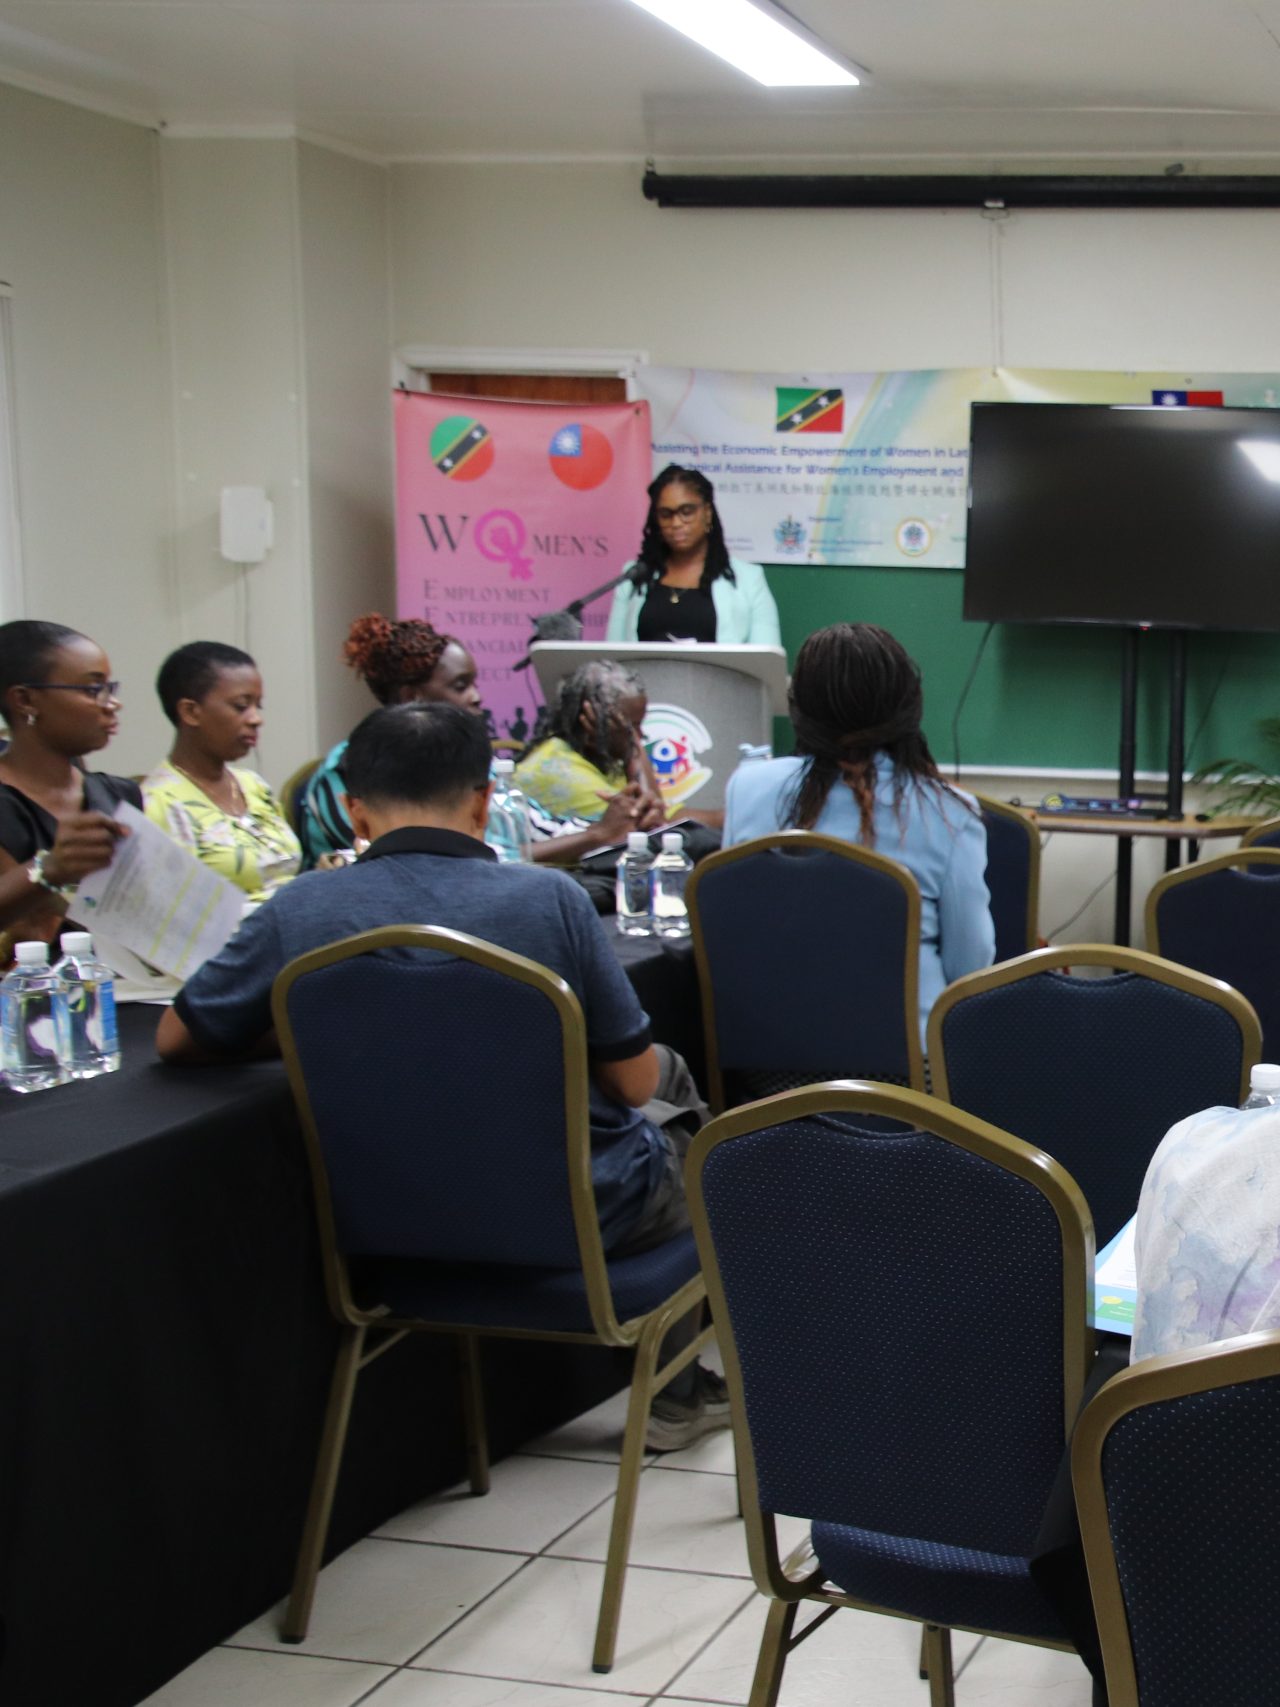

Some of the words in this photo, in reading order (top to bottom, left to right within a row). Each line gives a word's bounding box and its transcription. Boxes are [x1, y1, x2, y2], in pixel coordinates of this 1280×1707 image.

[701, 443, 718, 454] the
[722, 444, 777, 455] Economic
[782, 445, 867, 458] Empowerment
[870, 446, 882, 456] of
[886, 447, 931, 457] Women
[935, 447, 945, 457] in
[725, 463, 782, 474] Assistance
[786, 464, 802, 474] for
[863, 466, 937, 478] Employment
[942, 466, 964, 476] and
